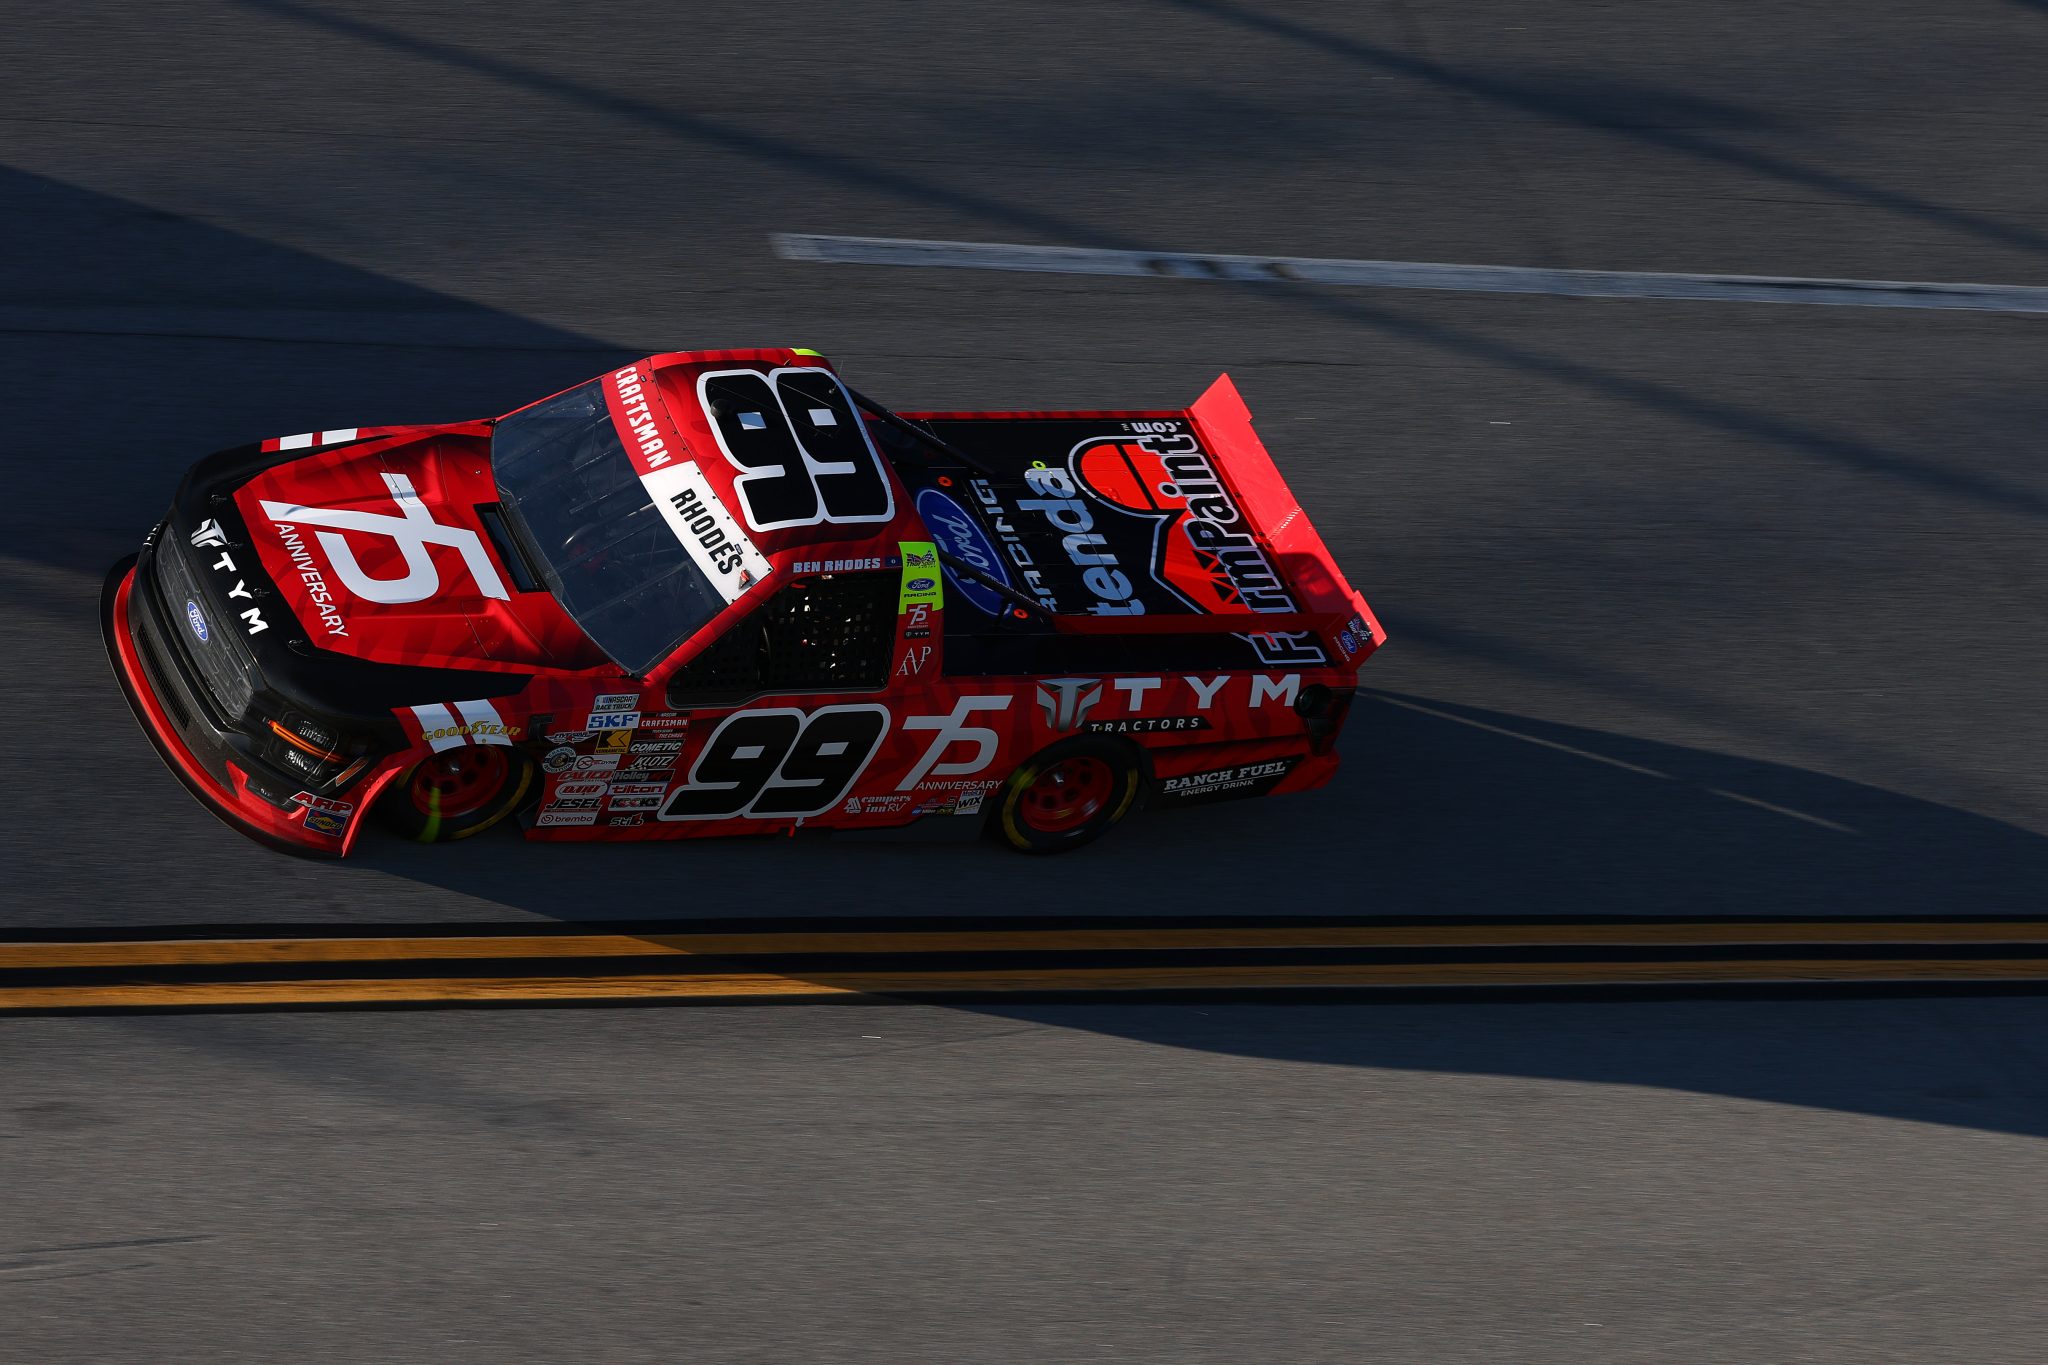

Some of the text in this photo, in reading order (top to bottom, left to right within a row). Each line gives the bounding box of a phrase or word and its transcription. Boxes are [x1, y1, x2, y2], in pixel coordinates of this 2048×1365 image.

[615, 366, 671, 468] CRAFTSMAN
[697, 367, 895, 532] 99
[258, 472, 511, 604] 75
[670, 488, 743, 575] RHODES
[793, 557, 881, 574] BEN RHODES
[275, 523, 349, 637] ANNIVERSARY
[911, 578, 931, 589] Ford
[212, 551, 270, 635] TYM
[908, 603, 929, 625] 75
[1113, 673, 1302, 712] TYM
[588, 714, 639, 728] SKF
[640, 719, 688, 727] CRAFTSMAN
[1091, 717, 1201, 732] TRACTORS
[422, 721, 522, 741] GOODYEAR
[630, 742, 682, 752] COMETIC
[895, 695, 1014, 792] 75
[635, 756, 674, 767] KLOTZ
[656, 703, 892, 822] 99
[614, 770, 650, 782] Holley
[1163, 760, 1287, 791] RANCH FUEL
[612, 785, 663, 793] tilton
[916, 780, 1003, 791] ANNIVERSARY
[1180, 778, 1255, 796] ENERGY DRINK
[545, 799, 602, 809] JESEL
[861, 794, 912, 806] campers
[307, 816, 344, 830] SUNOCO
[555, 815, 593, 823] brembo
